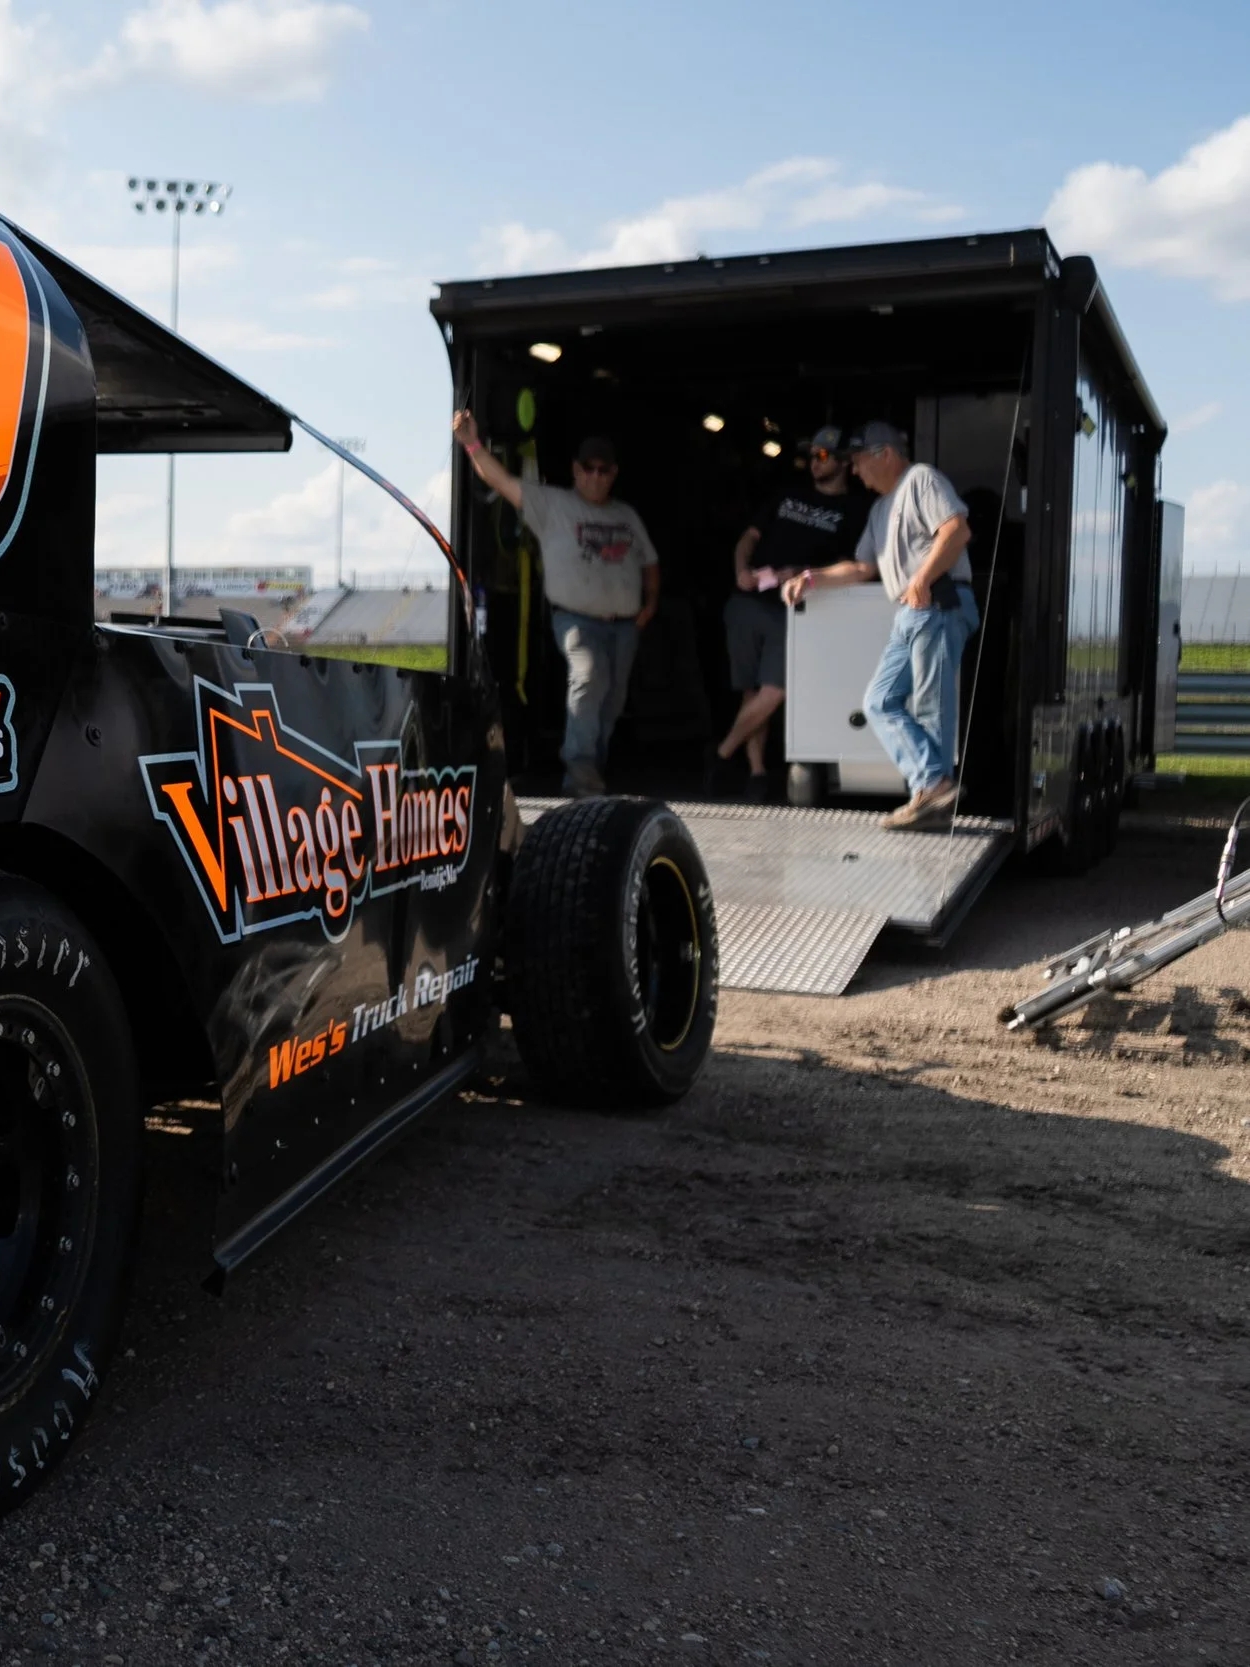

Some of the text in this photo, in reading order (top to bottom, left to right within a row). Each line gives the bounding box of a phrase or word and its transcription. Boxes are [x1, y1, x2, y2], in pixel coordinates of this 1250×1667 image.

[161, 740, 470, 918] Village Homes
[269, 953, 480, 1090] Wes's Truck Repair
